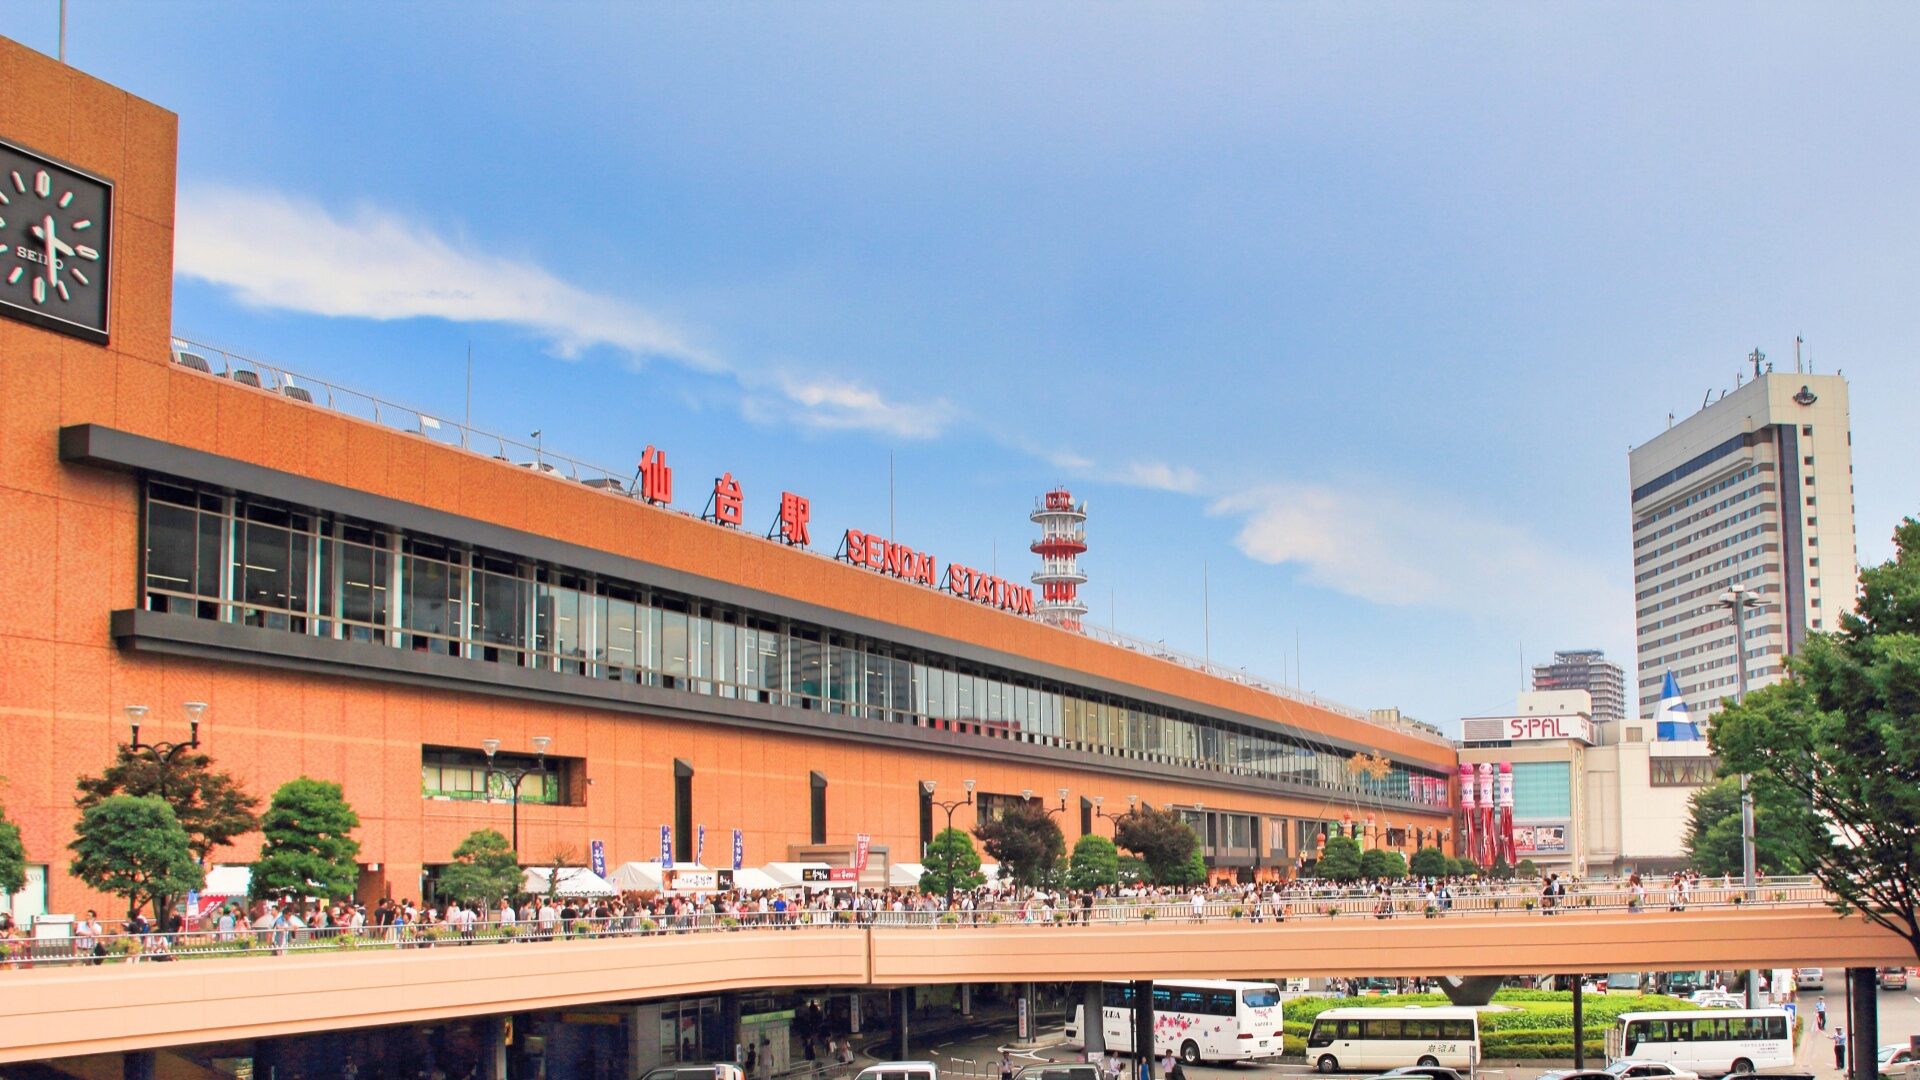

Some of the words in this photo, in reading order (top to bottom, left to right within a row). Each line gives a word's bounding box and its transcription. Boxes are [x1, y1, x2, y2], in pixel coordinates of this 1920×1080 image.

[17, 246, 63, 268] SEIO
[638, 444, 810, 545] 仙台駅
[847, 528, 936, 585] SENDAI
[950, 562, 1033, 614] STATION
[1510, 718, 1569, 738] S-PAL
